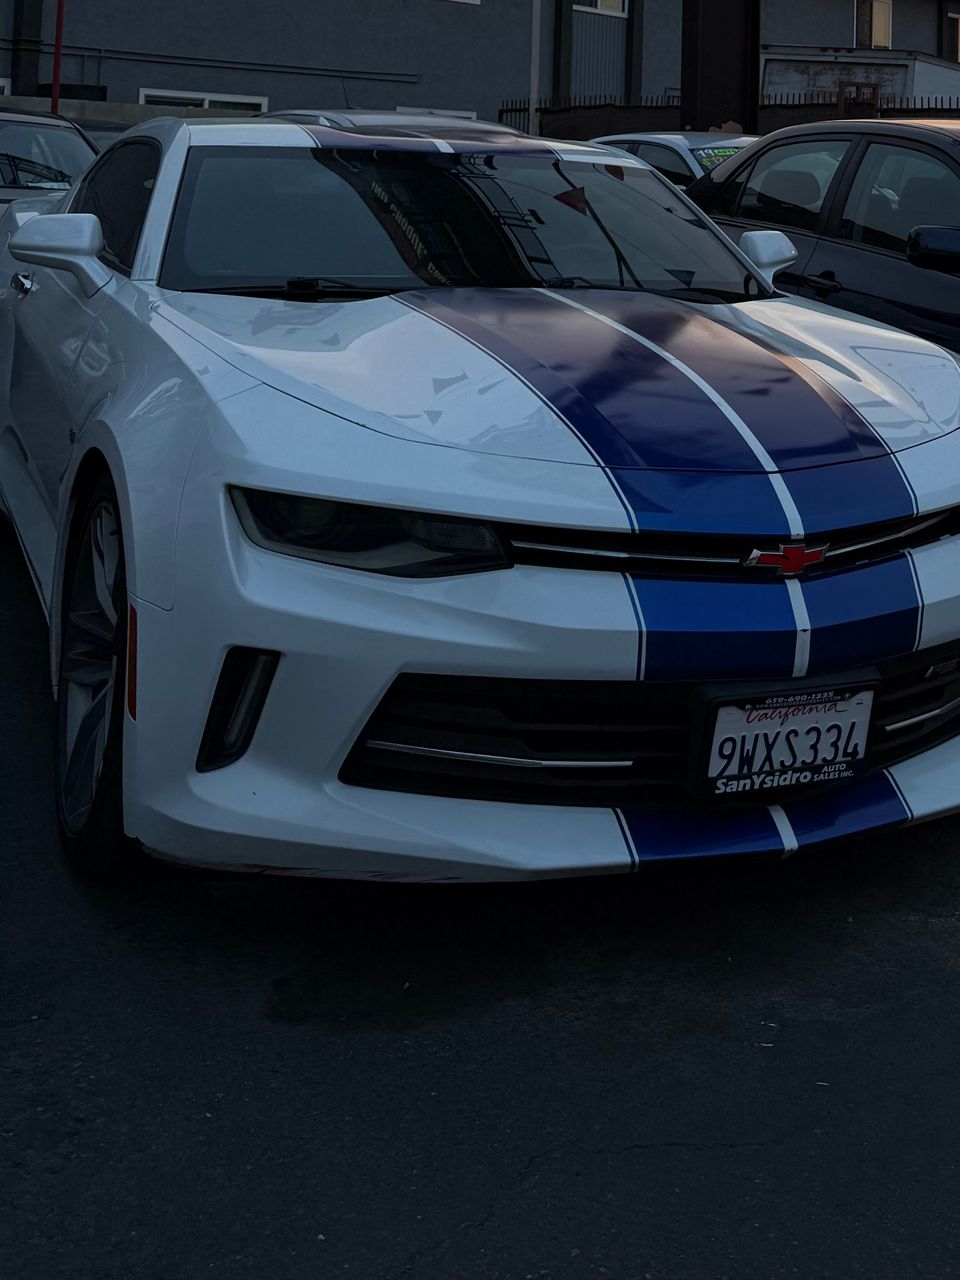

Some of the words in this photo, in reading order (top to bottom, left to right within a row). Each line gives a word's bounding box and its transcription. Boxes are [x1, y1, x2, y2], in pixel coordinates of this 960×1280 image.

[746, 701, 847, 726] California
[716, 721, 859, 778] 9WXS334
[714, 770, 812, 794] SanYsidro
[821, 763, 847, 773] AUTO
[813, 772, 840, 781] SALES
